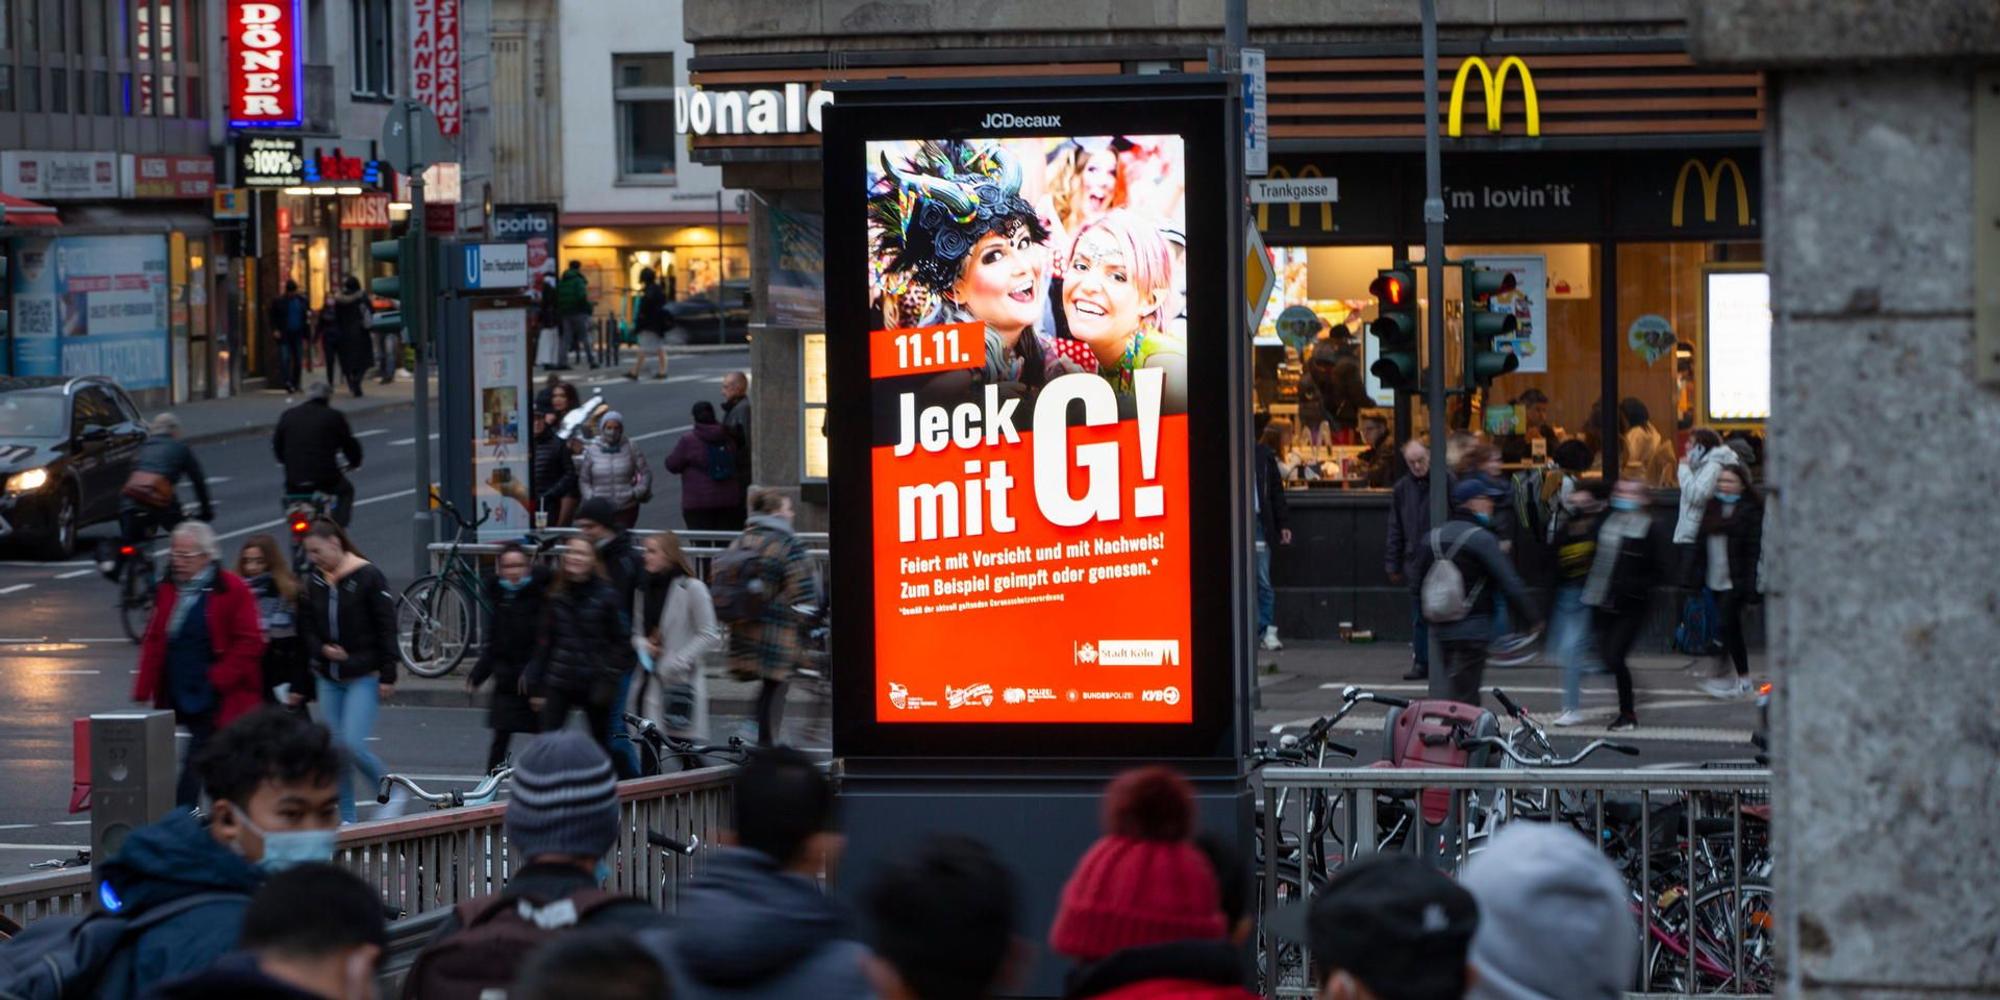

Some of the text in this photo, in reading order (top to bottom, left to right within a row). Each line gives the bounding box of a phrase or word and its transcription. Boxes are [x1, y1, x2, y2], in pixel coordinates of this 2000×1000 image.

[240, 3, 283, 115] DÖNER
[981, 113, 1061, 129] JCDecaux
[253, 151, 293, 175] 100%
[1259, 182, 1328, 199] Trankgasse
[341, 197, 387, 225] KIOSK
[496, 214, 547, 236] porta
[895, 329, 970, 368] 11.11.
[894, 384, 1021, 457] Jeck
[1033, 367, 1164, 527] G!
[898, 460, 1016, 543] mit
[900, 532, 1164, 575] Feiert mit Vorsicht und mit Nachweis!
[900, 581, 930, 600] Zum
[934, 574, 990, 597] Beispiel
[993, 568, 1049, 593] geimpft
[1052, 565, 1084, 585] oder
[1101, 647, 1154, 659] Stadt Köln
[1082, 691, 1134, 700] BUNDESPOLIZEI
[1141, 689, 1164, 702] KVB
